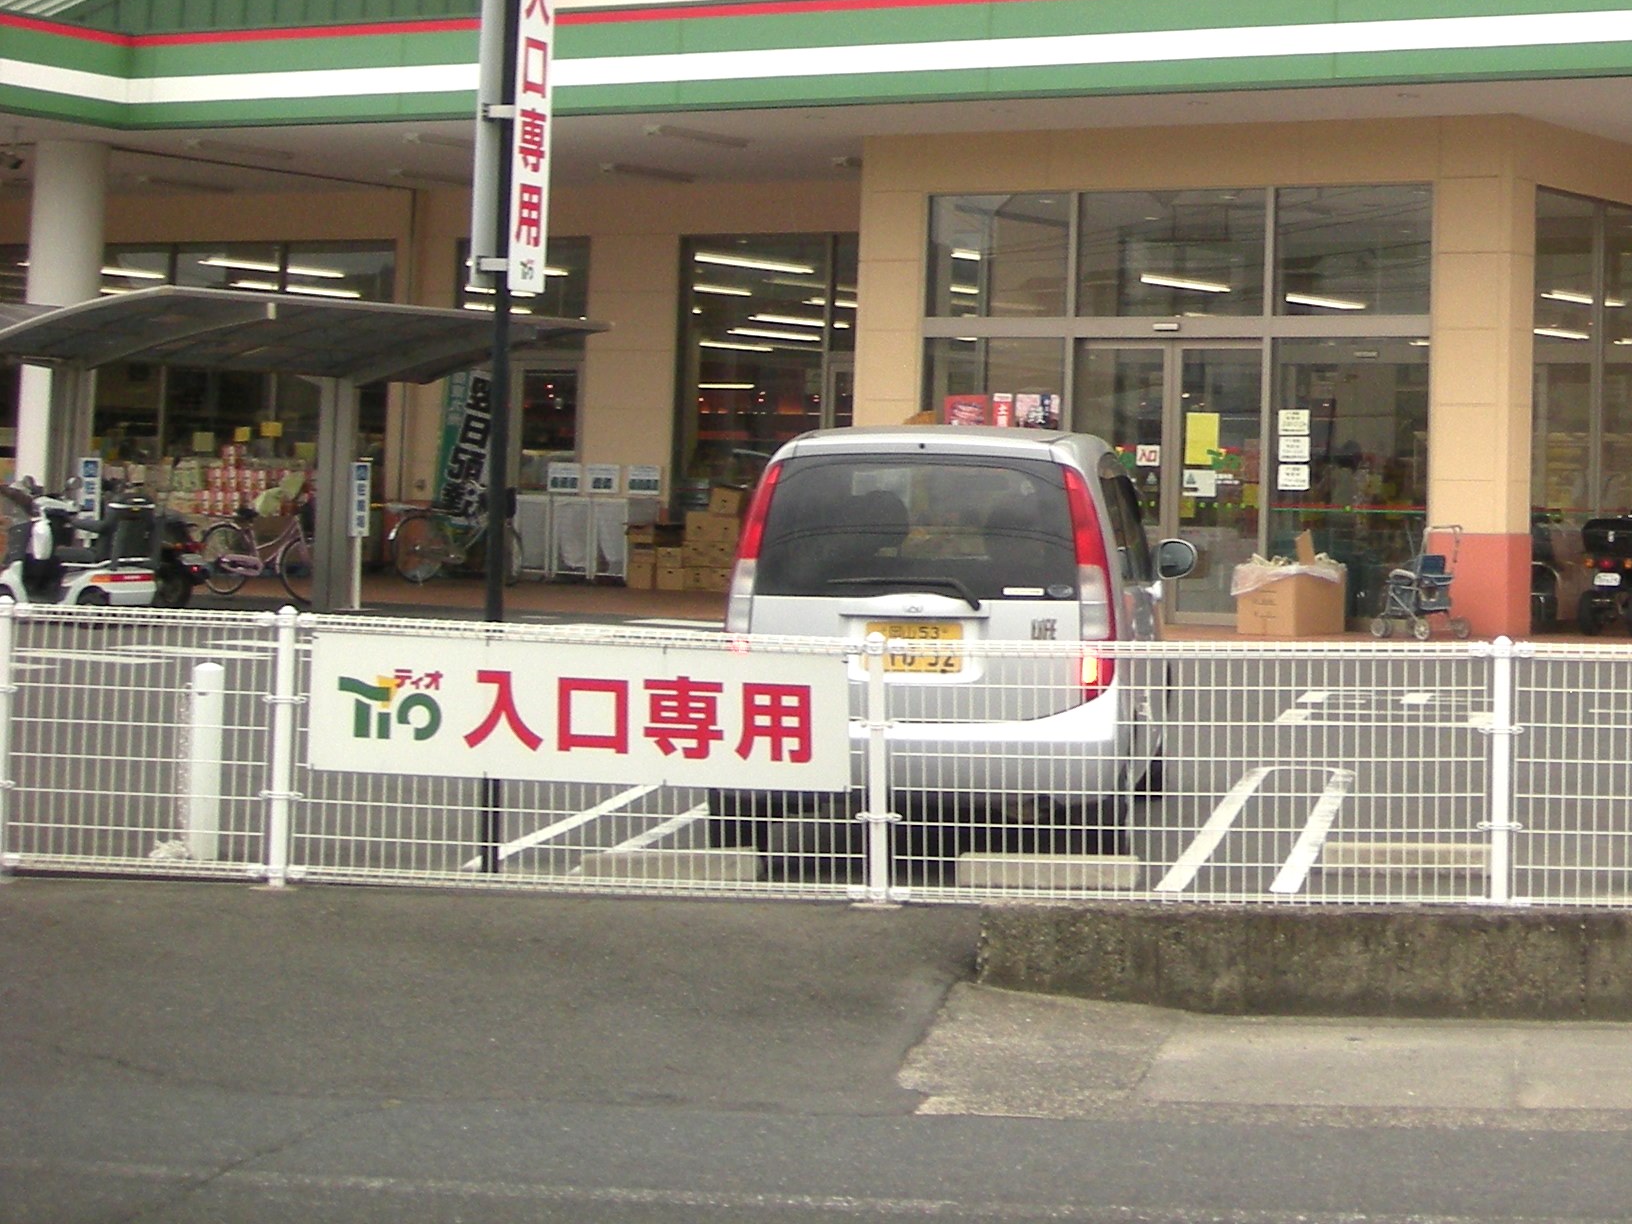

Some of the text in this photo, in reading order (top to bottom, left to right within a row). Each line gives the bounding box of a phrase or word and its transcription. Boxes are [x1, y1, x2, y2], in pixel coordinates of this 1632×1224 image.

[394, 669, 443, 690] ティオ
[463, 669, 813, 764] 入口専用
